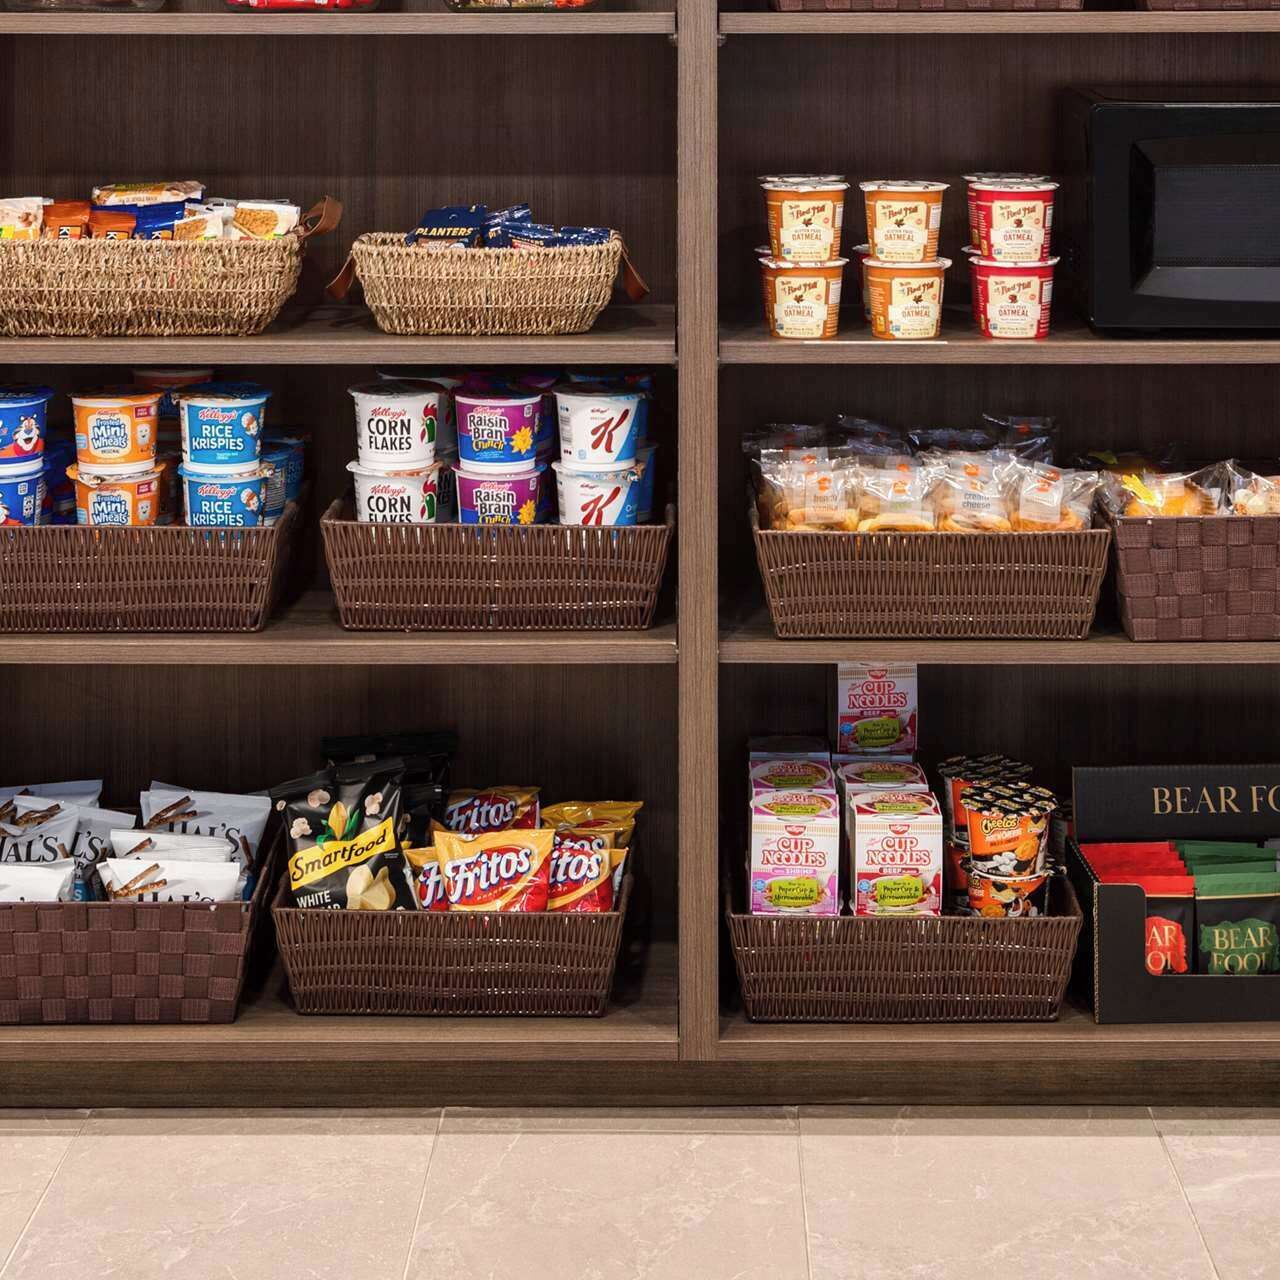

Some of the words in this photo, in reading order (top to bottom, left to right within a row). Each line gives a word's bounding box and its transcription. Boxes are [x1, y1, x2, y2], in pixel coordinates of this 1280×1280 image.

[415, 227, 473, 237] PLANTERS
[792, 233, 822, 241] OATMEAL
[884, 232, 915, 242] OATMEAL
[1003, 232, 1034, 242] OATMEAL
[784, 309, 815, 317] OATMEAL
[901, 308, 931, 318] OATMEAL
[998, 308, 1029, 318] OATMEAL
[198, 409, 239, 423] Kellogg's
[370, 407, 408, 418] Kellogg's
[368, 418, 411, 436] CORN
[467, 414, 509, 429] Raisin
[94, 425, 125, 438] Mini
[202, 425, 232, 438] RICE
[471, 426, 504, 441] Bran
[591, 408, 630, 453] K
[92, 436, 128, 449] Wheats
[191, 436, 244, 452] KRISPIES
[369, 436, 412, 452] FLAKES
[472, 438, 505, 452] Crunch
[197, 484, 238, 498] Kellogg's
[370, 484, 407, 495] Kellogg's
[367, 495, 411, 514] CORN
[475, 490, 516, 505] Raisin
[94, 500, 126, 515] Mini
[201, 501, 232, 515] RICE
[478, 501, 511, 516] Bran
[581, 486, 622, 525] K
[962, 500, 991, 511] cheese
[92, 511, 128, 525] Wheats
[191, 513, 244, 526] KRISPIES
[861, 680, 896, 695] CUP
[848, 692, 907, 710] NOODLES
[1152, 786, 1241, 816] BEAR
[446, 796, 515, 829] Fritos
[981, 817, 1018, 835] Cheetos
[777, 837, 814, 853] CUP
[881, 836, 918, 853] CUP
[291, 828, 388, 881] Smartfood
[761, 850, 826, 868] NOODLES
[866, 849, 931, 867] NOODLES
[446, 846, 531, 902] Fritos
[297, 891, 331, 909] WHITE
[1213, 926, 1272, 950] BEAR
